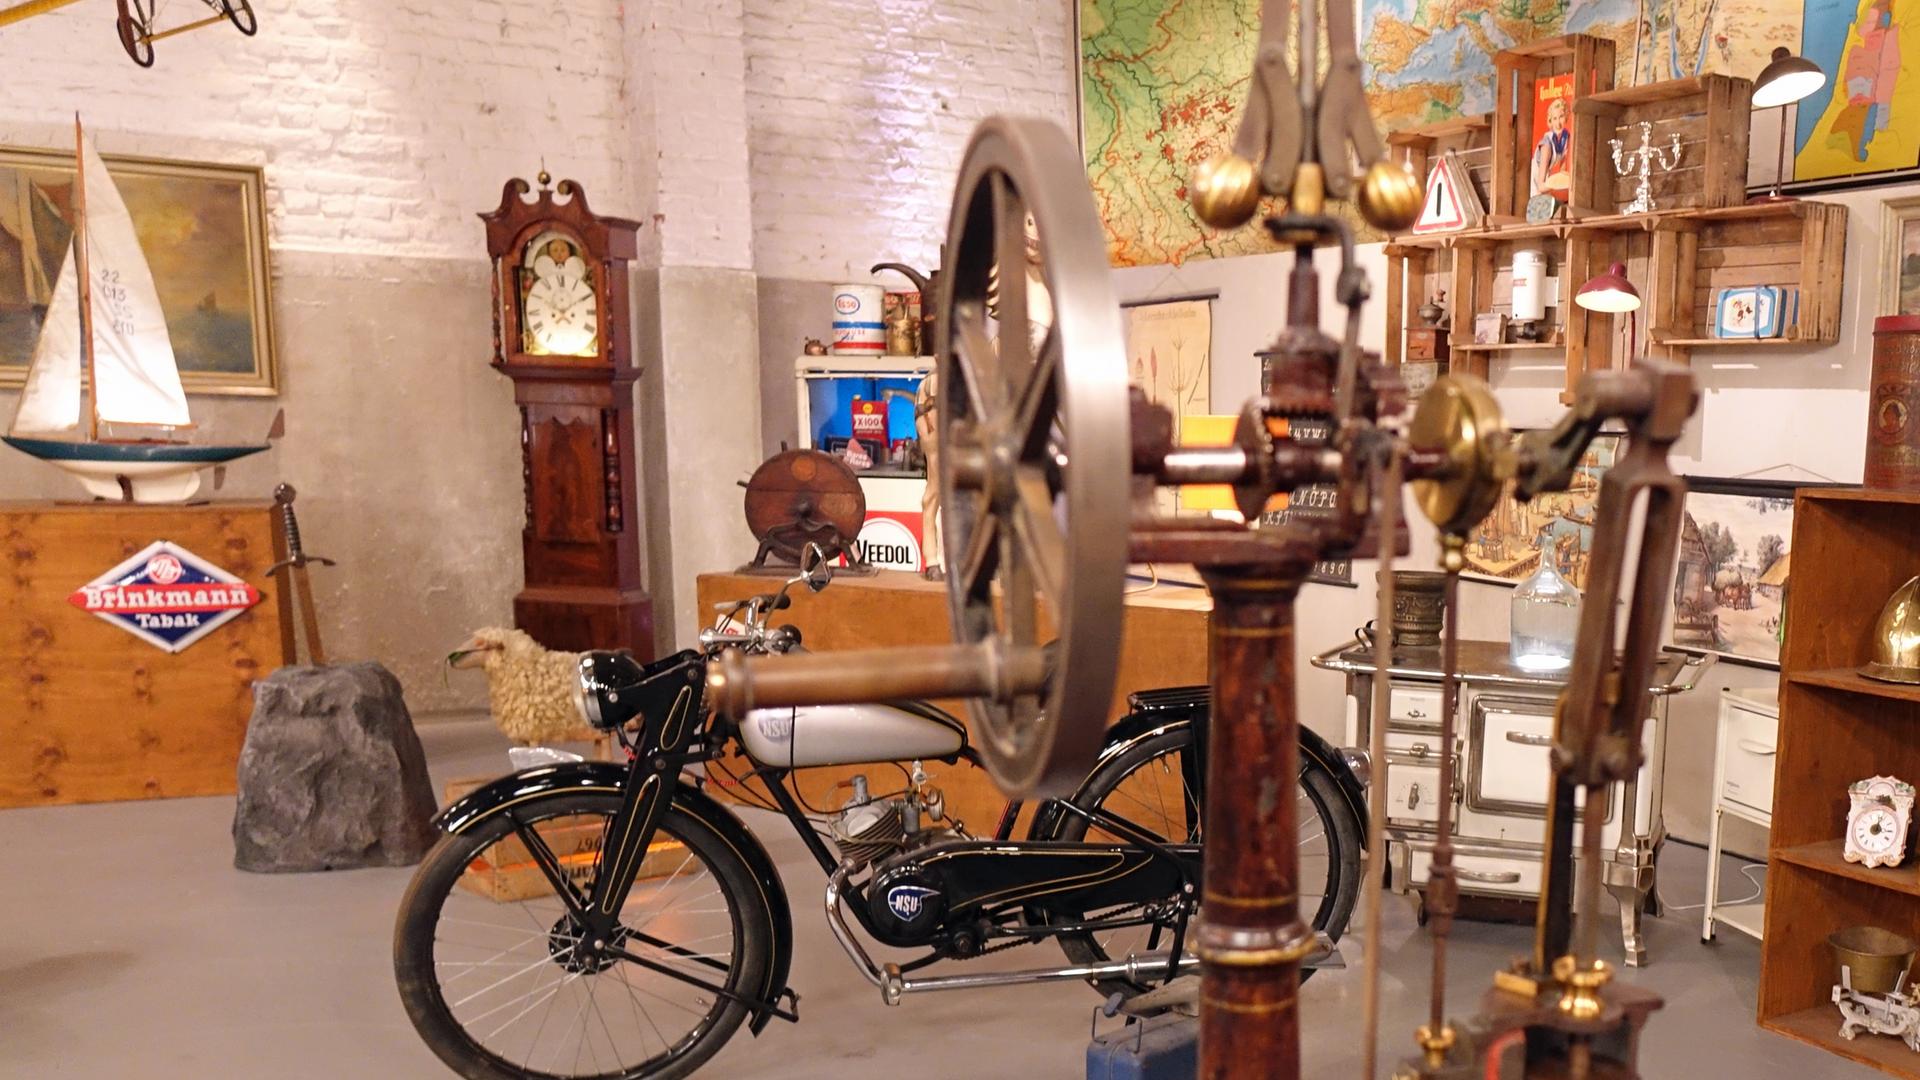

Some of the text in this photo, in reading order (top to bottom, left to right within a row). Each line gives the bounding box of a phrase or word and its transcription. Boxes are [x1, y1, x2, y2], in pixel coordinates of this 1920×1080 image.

[856, 539, 914, 565] VEEDOL
[85, 587, 250, 609] Brinkmann
[135, 612, 200, 629] Tabak
[894, 894, 919, 916] NSU
